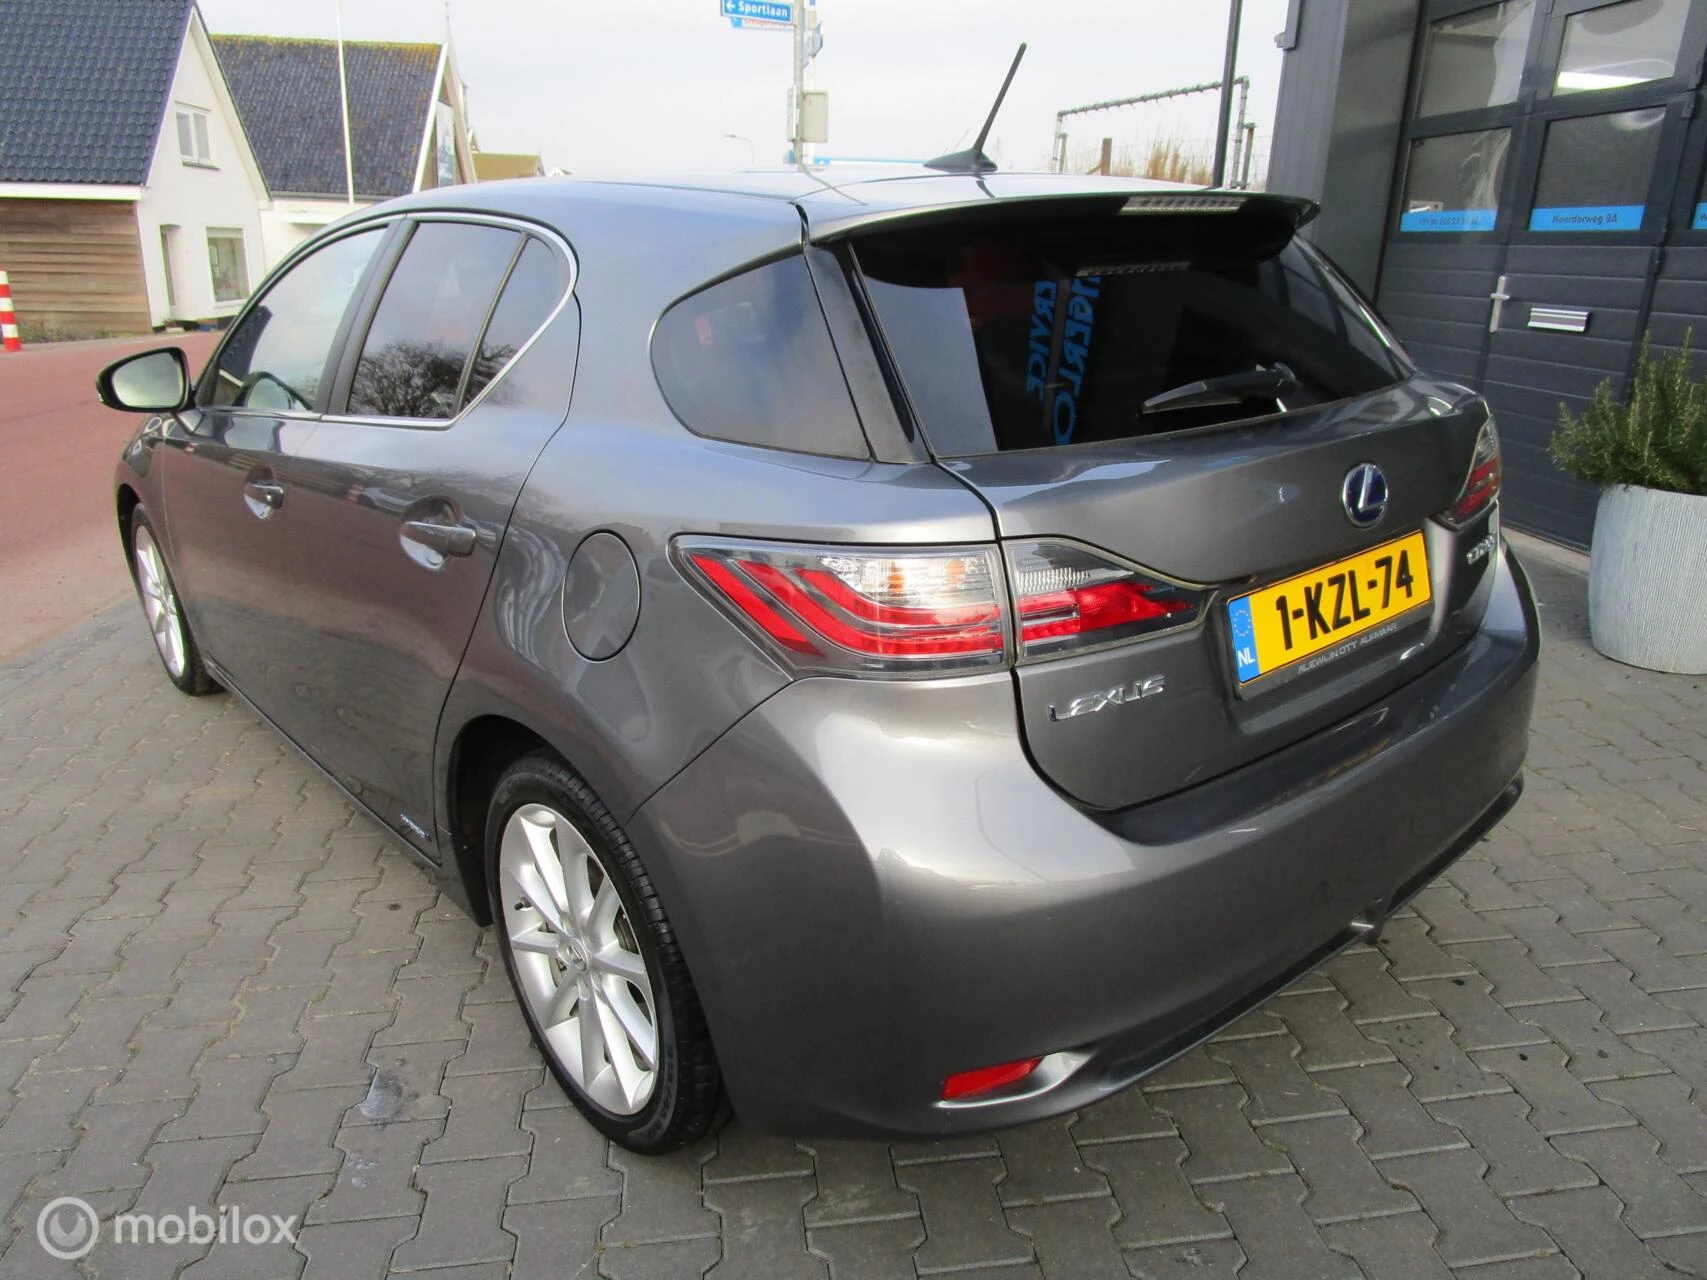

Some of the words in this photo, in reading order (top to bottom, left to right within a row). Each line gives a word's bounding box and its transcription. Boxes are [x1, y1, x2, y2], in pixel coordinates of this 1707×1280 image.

[738, 1, 788, 17] Sportlaan
[1552, 214, 1604, 225] Noorderweg
[1275, 549, 1414, 651] 1-KZL-74
[1237, 647, 1256, 667] NL
[1047, 674, 1165, 721] LEXUS
